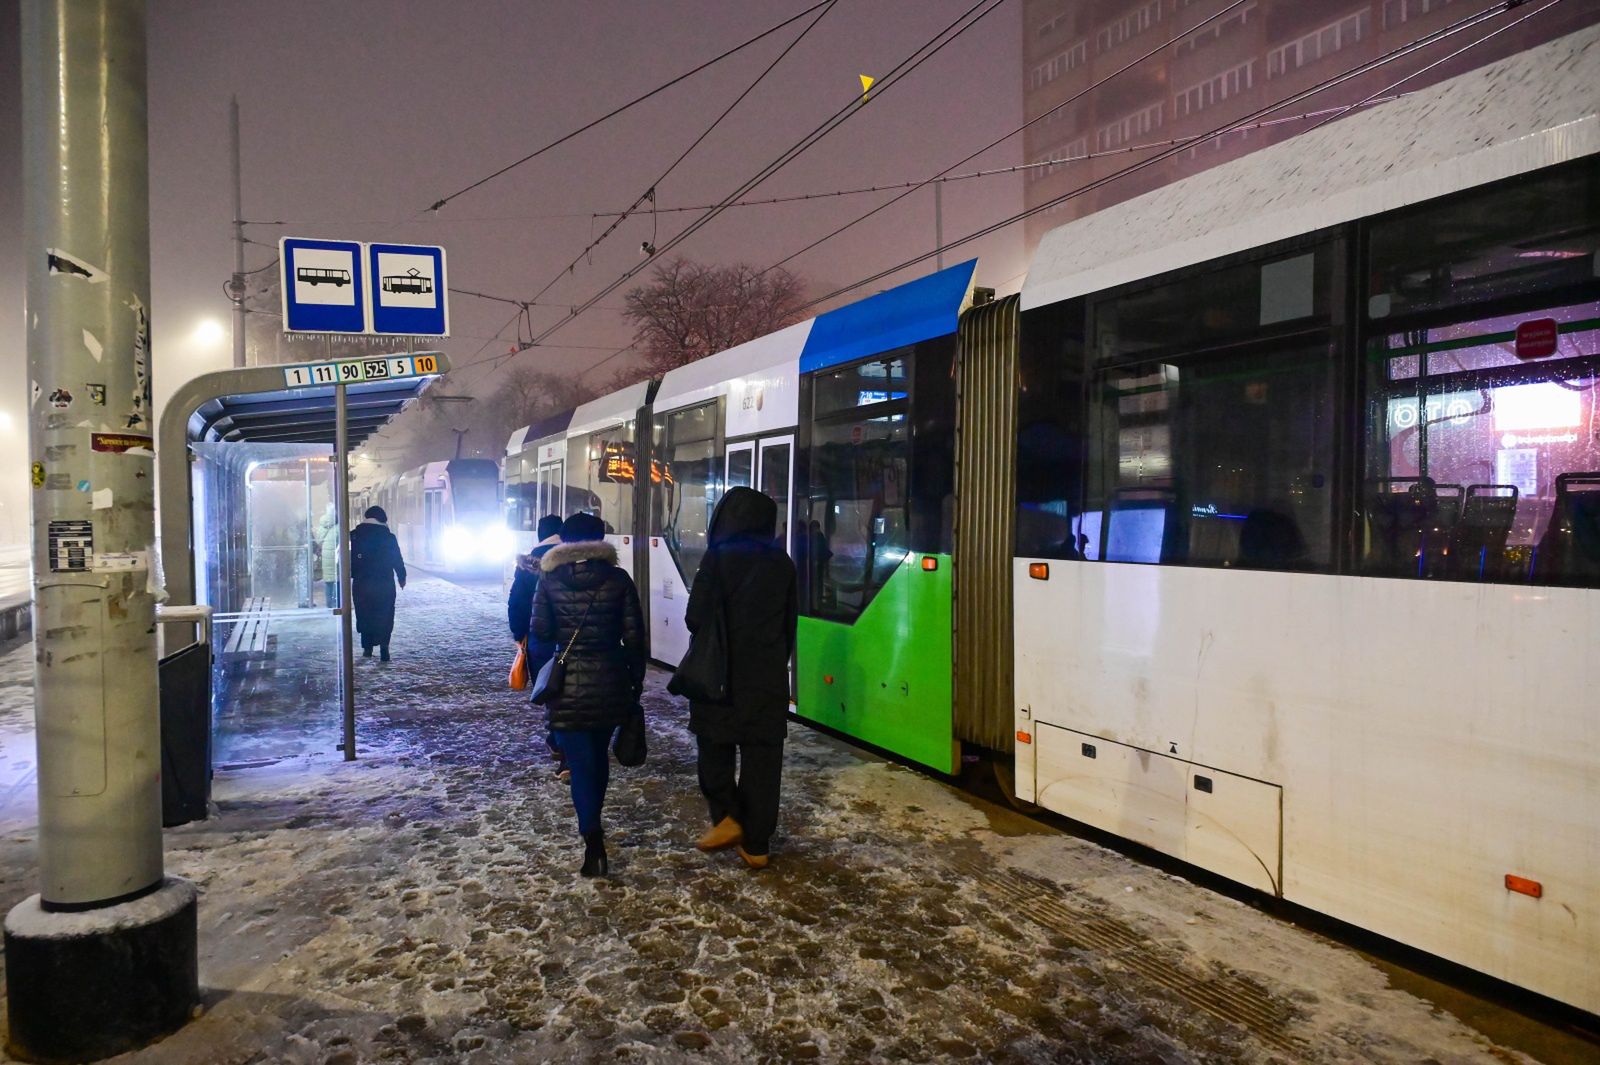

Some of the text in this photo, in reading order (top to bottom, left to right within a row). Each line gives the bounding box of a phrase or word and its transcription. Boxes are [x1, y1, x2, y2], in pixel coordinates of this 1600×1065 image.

[293, 357, 433, 384] 1 11 90 525 5 10
